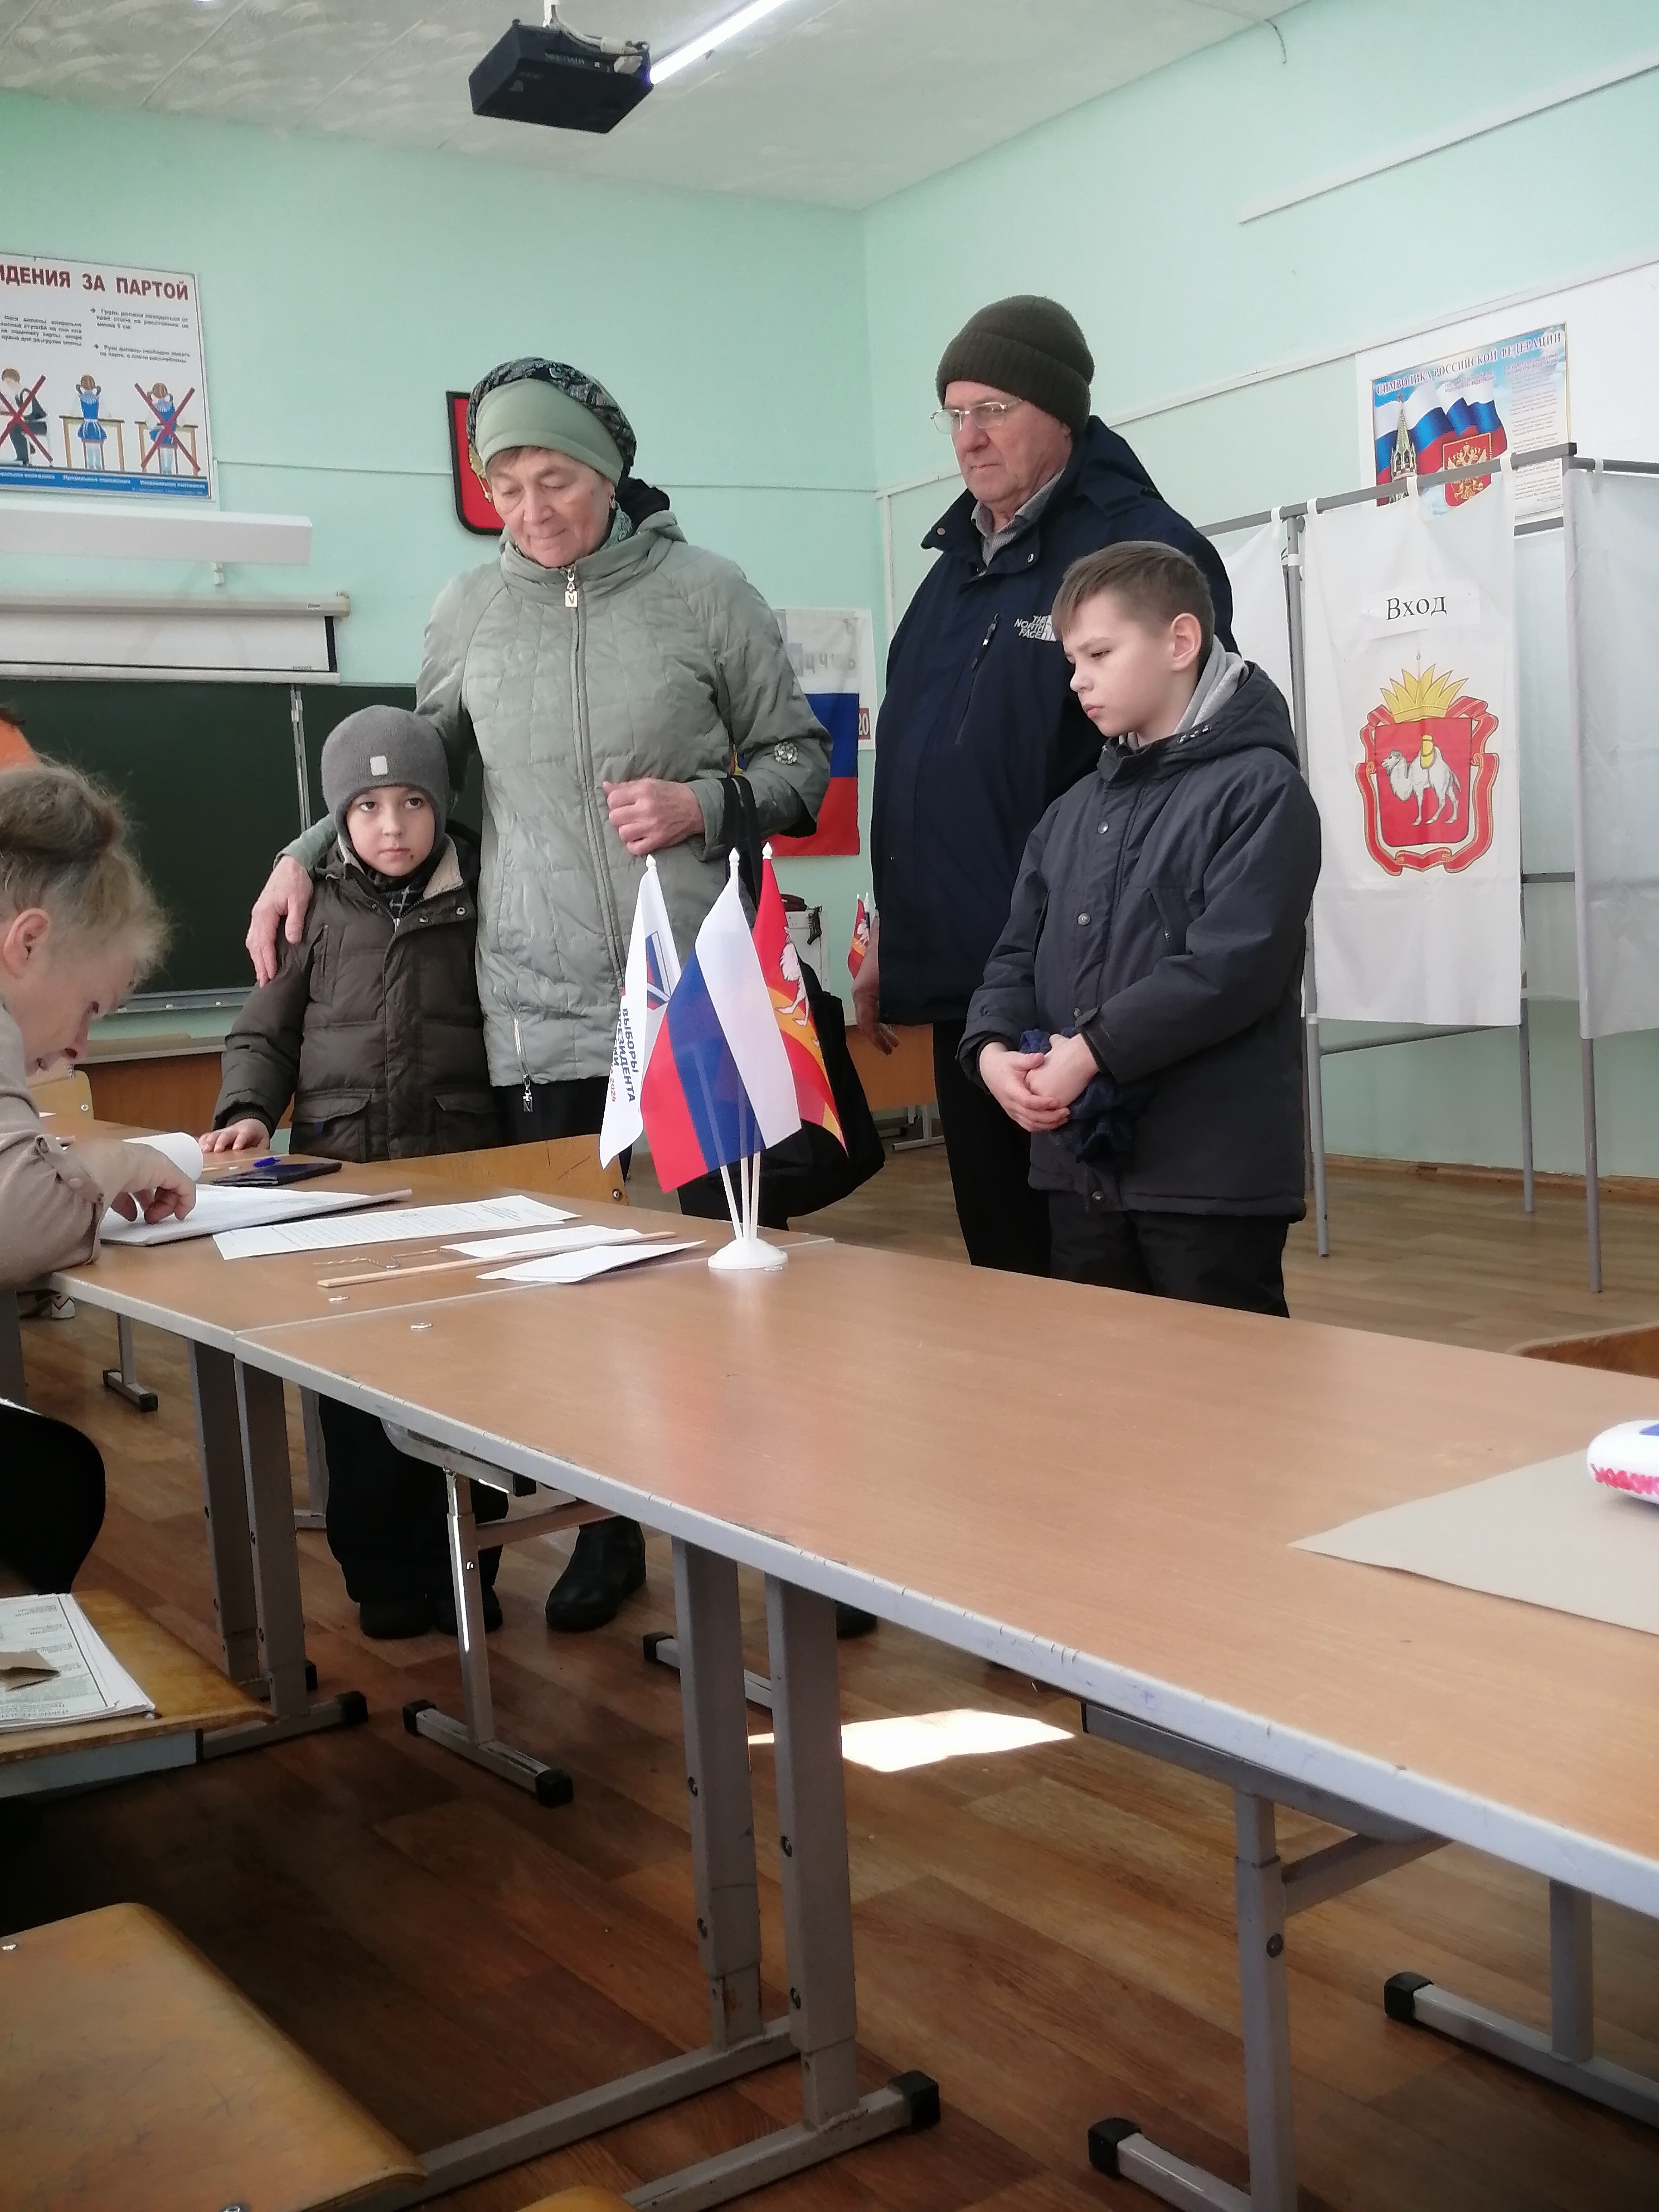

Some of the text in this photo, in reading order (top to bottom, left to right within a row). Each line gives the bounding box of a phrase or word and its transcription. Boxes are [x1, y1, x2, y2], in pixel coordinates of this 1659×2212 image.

[83, 273, 105, 292] ЗА
[116, 276, 188, 300] ПАРТОЙ
[1434, 348, 1497, 377] РОССИЙСКОЙ
[1500, 333, 1560, 358] ФЕДЕРАЦИИ
[1386, 596, 1447, 620] Вход
[1013, 618, 1046, 633] NORTH
[1018, 628, 1041, 638] FACE
[622, 1008, 639, 1073] ВЫБОРЫ
